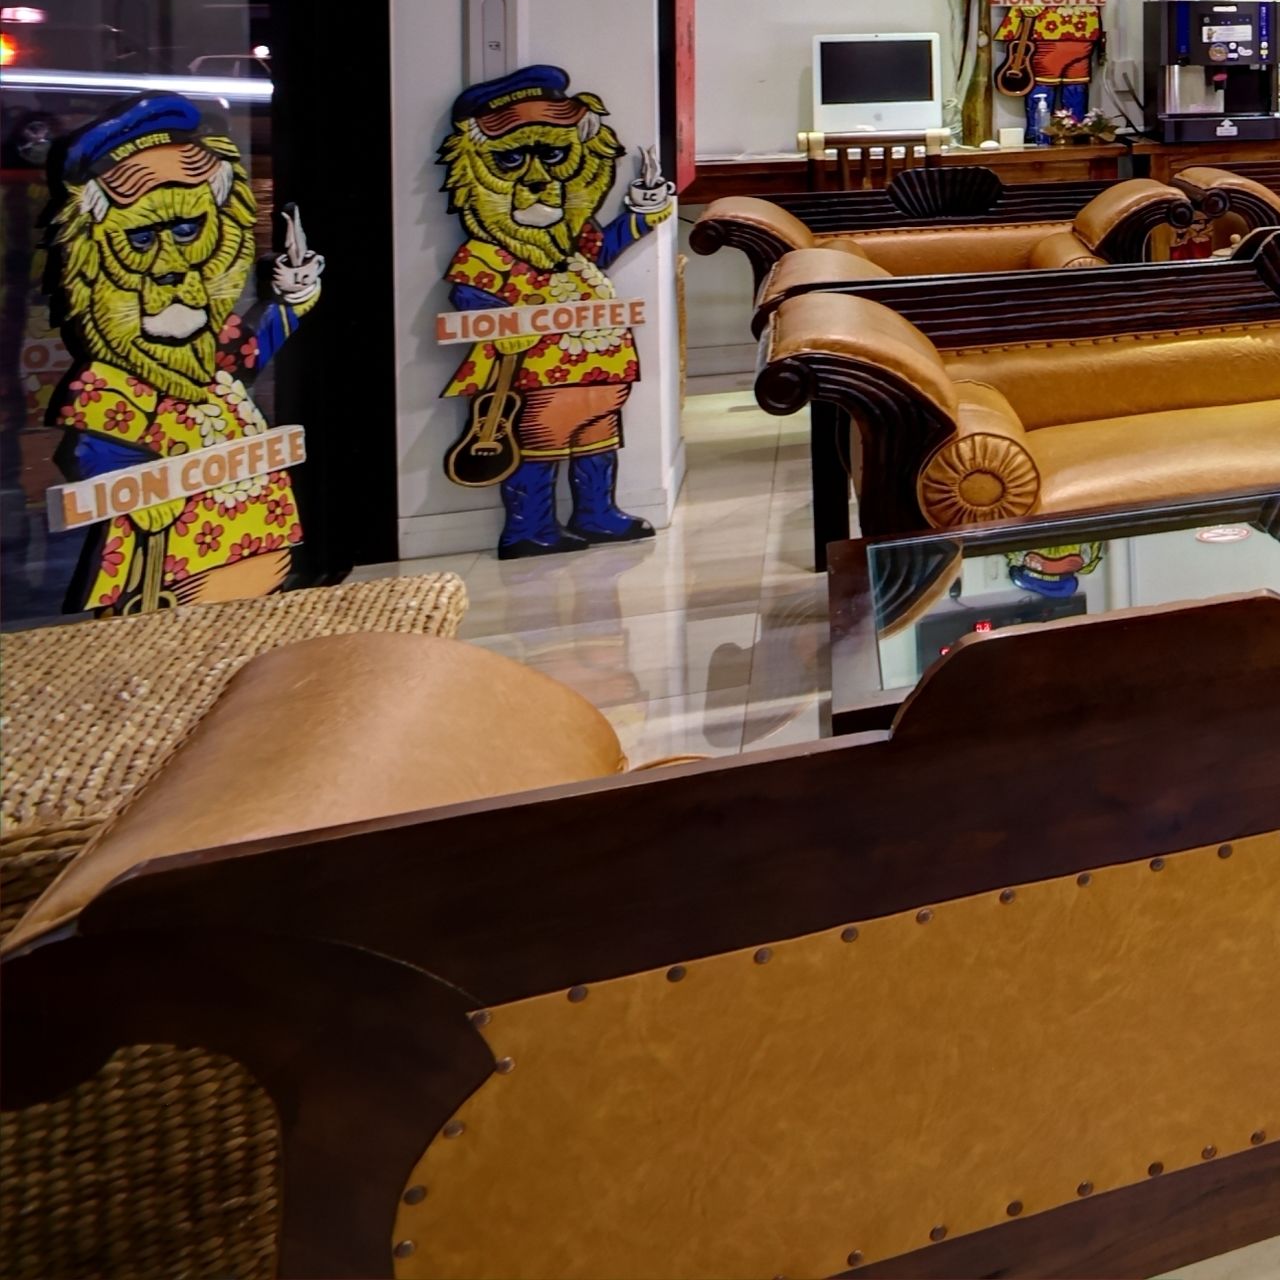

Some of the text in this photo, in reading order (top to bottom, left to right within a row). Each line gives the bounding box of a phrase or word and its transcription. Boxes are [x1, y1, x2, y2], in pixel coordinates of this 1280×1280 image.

[135, 133, 171, 150] COFFEE
[642, 191, 657, 202] LC
[436, 301, 646, 340] LION COFFEE
[63, 430, 306, 529] LION COFFEE
